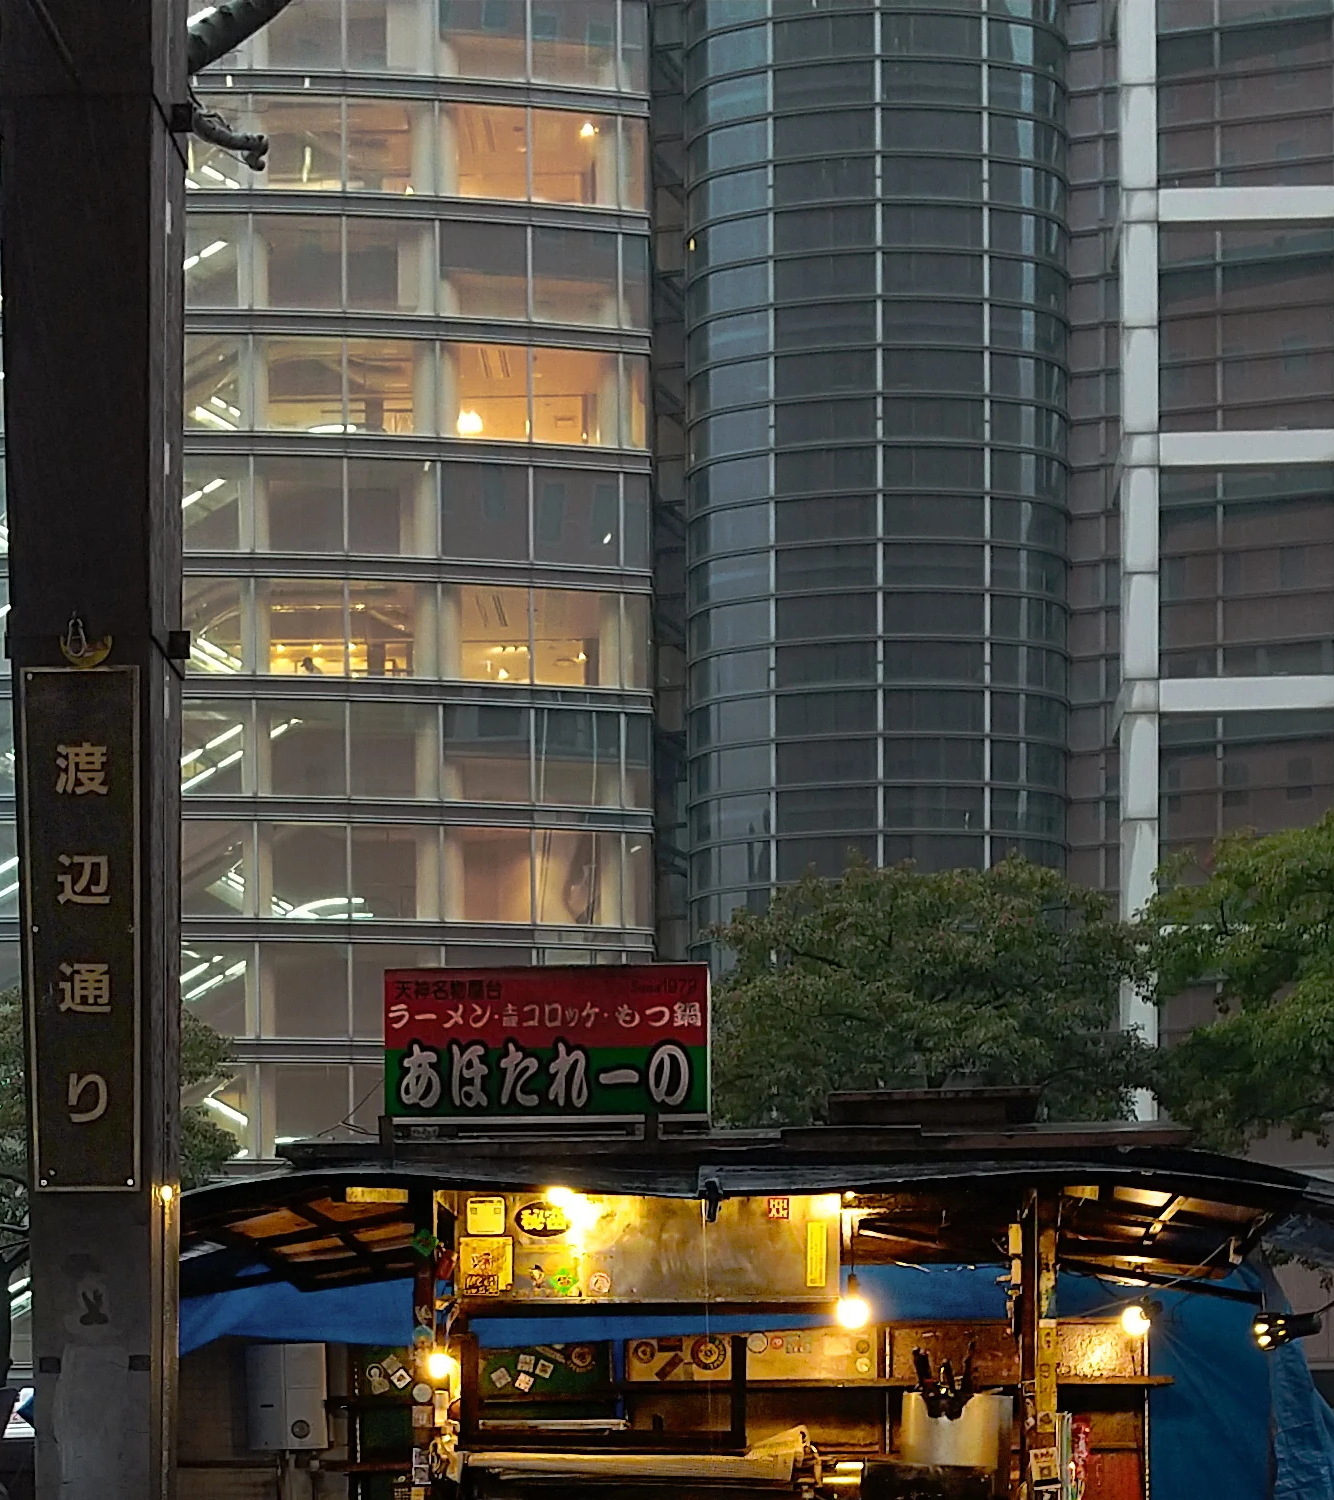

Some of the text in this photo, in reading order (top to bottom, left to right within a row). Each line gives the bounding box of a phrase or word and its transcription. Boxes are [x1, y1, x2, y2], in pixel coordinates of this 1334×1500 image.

[54, 742, 111, 1123] 渡辺通り
[400, 1042, 689, 1108] あほたれーの
